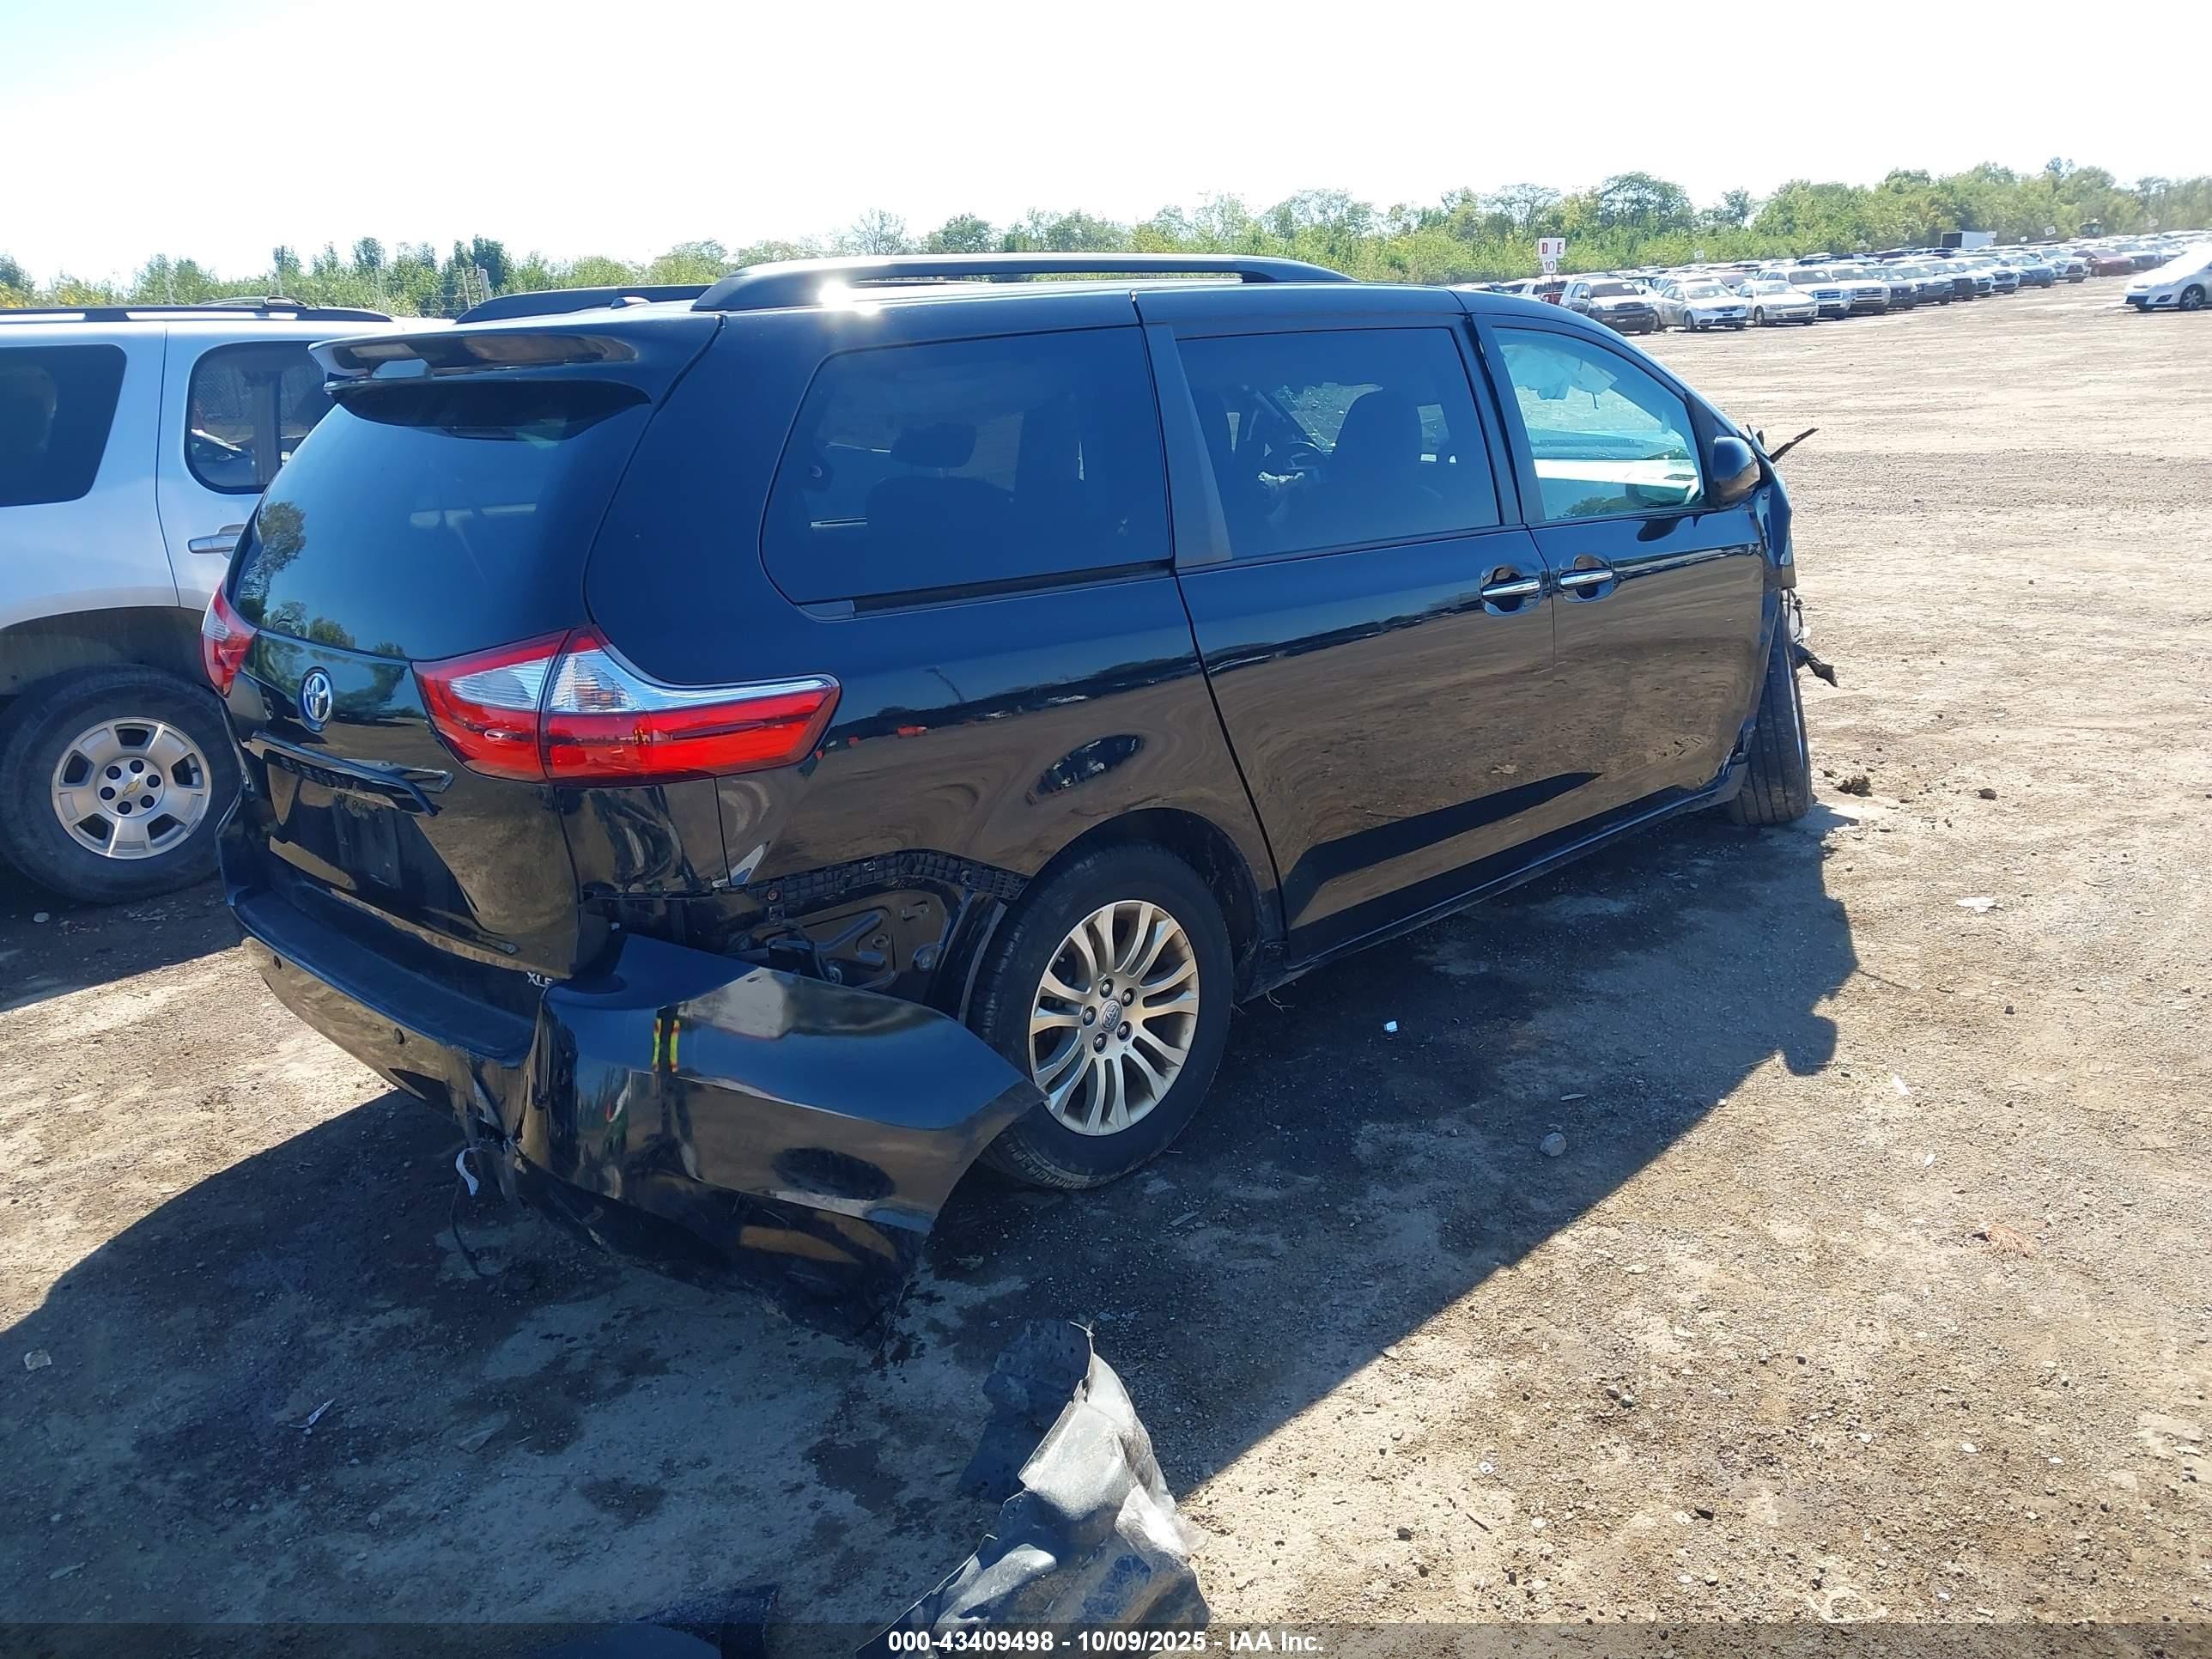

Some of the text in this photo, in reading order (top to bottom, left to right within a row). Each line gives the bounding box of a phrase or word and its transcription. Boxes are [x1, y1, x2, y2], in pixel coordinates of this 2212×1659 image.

[1541, 242, 1562, 254] D E
[1545, 260, 1555, 271] 10
